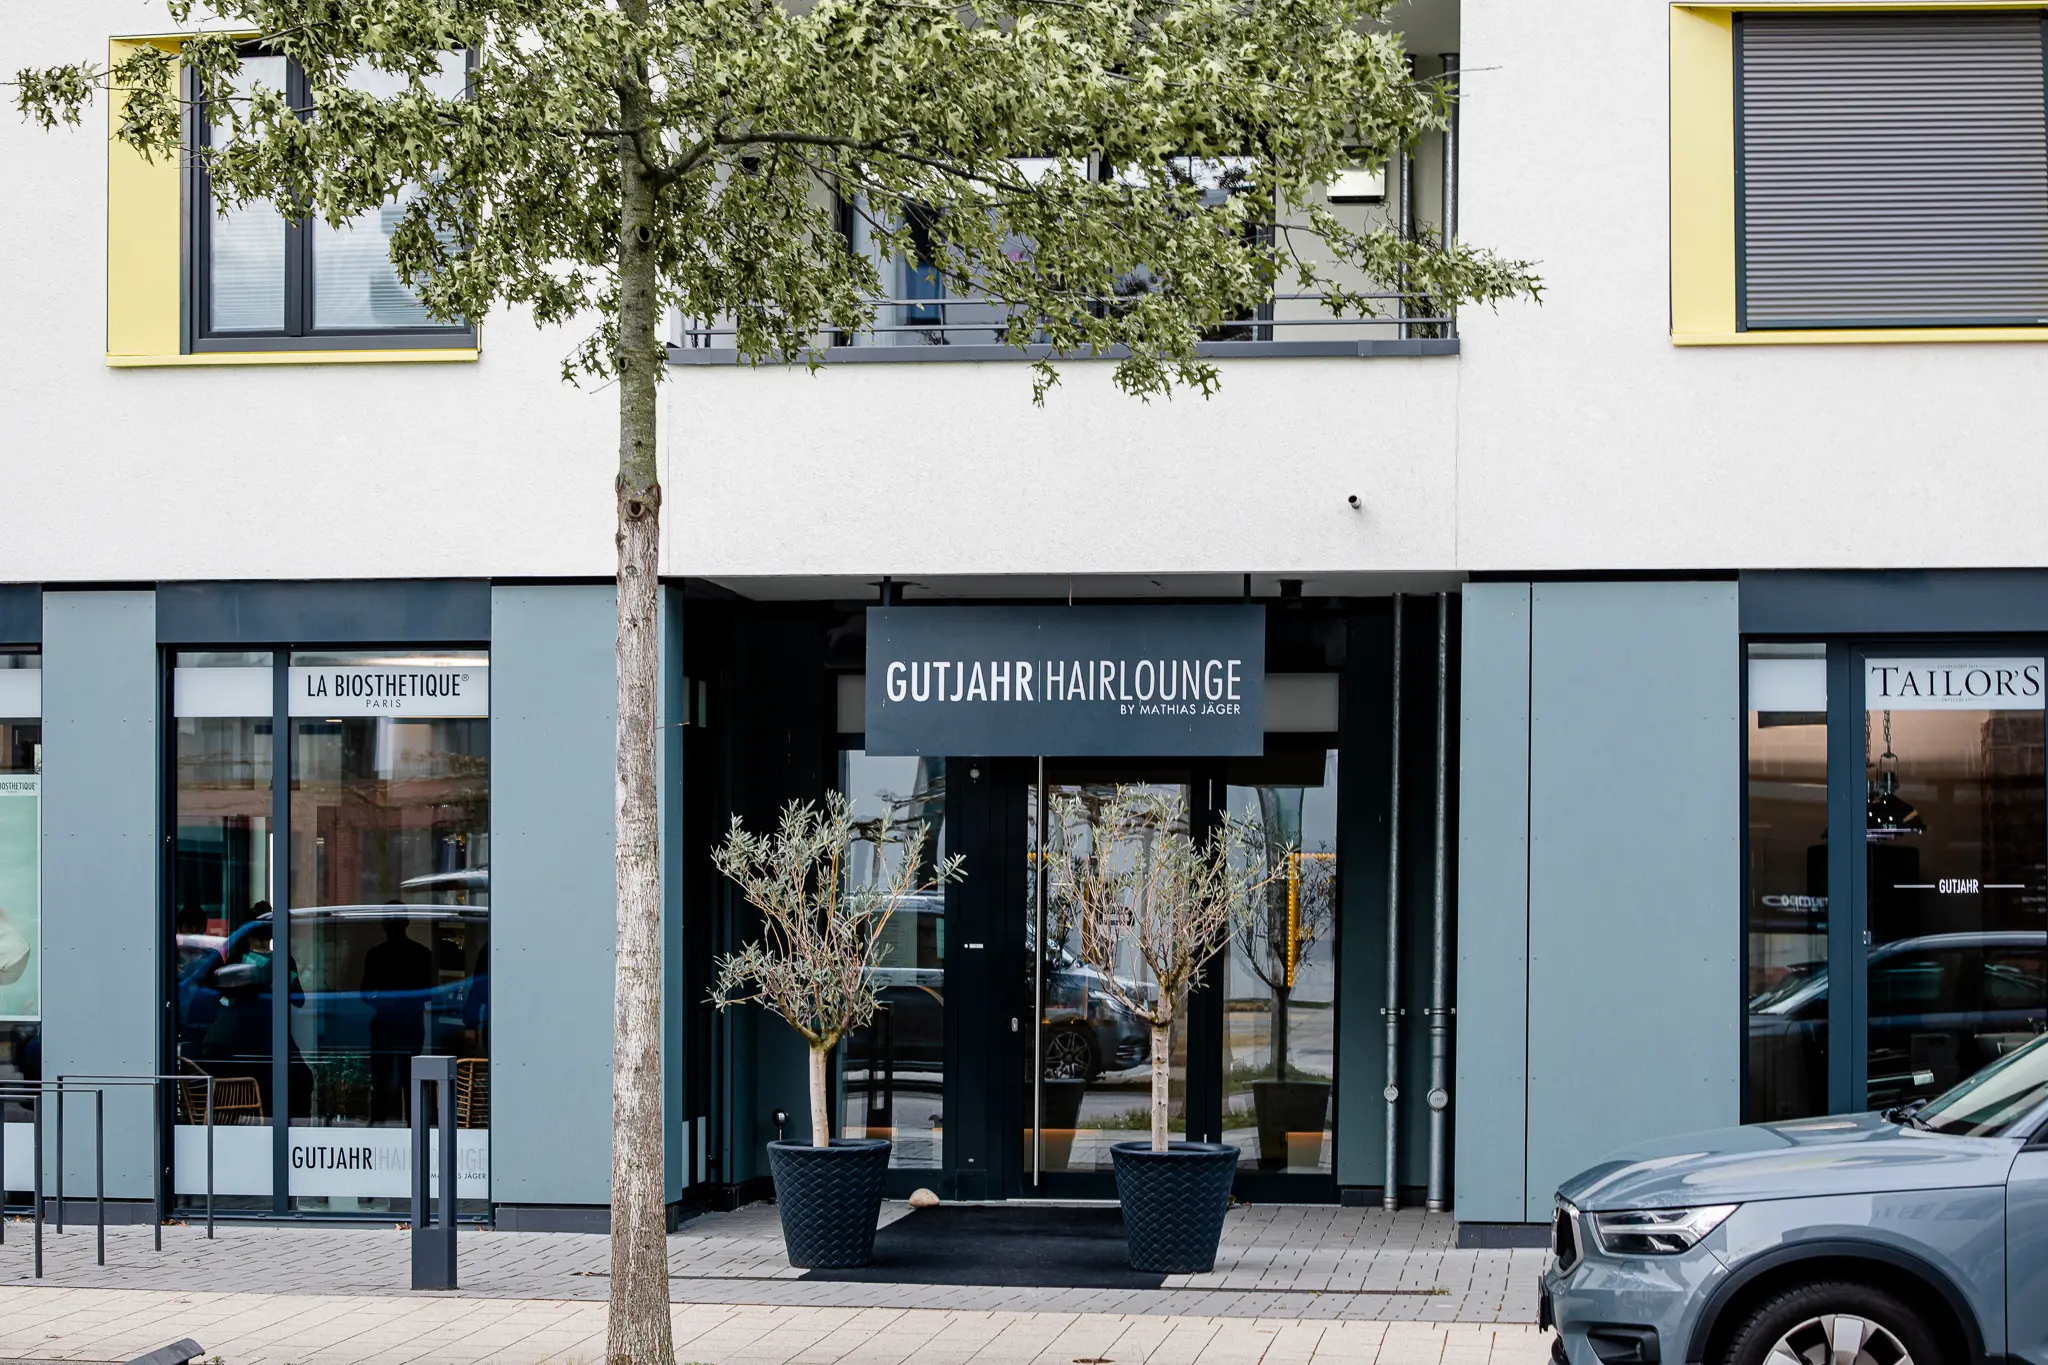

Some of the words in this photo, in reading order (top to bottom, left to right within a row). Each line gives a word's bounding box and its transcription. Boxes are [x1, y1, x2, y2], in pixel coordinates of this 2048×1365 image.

[307, 674, 328, 697] LA
[886, 660, 1034, 702] GUTJAHR
[1046, 659, 1242, 701] HAIRLOUNGE
[1871, 665, 2040, 697] TAILOR'S
[366, 699, 402, 708] PARIS
[1120, 704, 1135, 715] BY
[1140, 704, 1197, 715] MATHIAS
[1201, 702, 1241, 715] JÄGER
[1938, 878, 1979, 894] GUTJAHR
[292, 1146, 373, 1170] GUTJAHR
[464, 1172, 487, 1180] JÄGER
